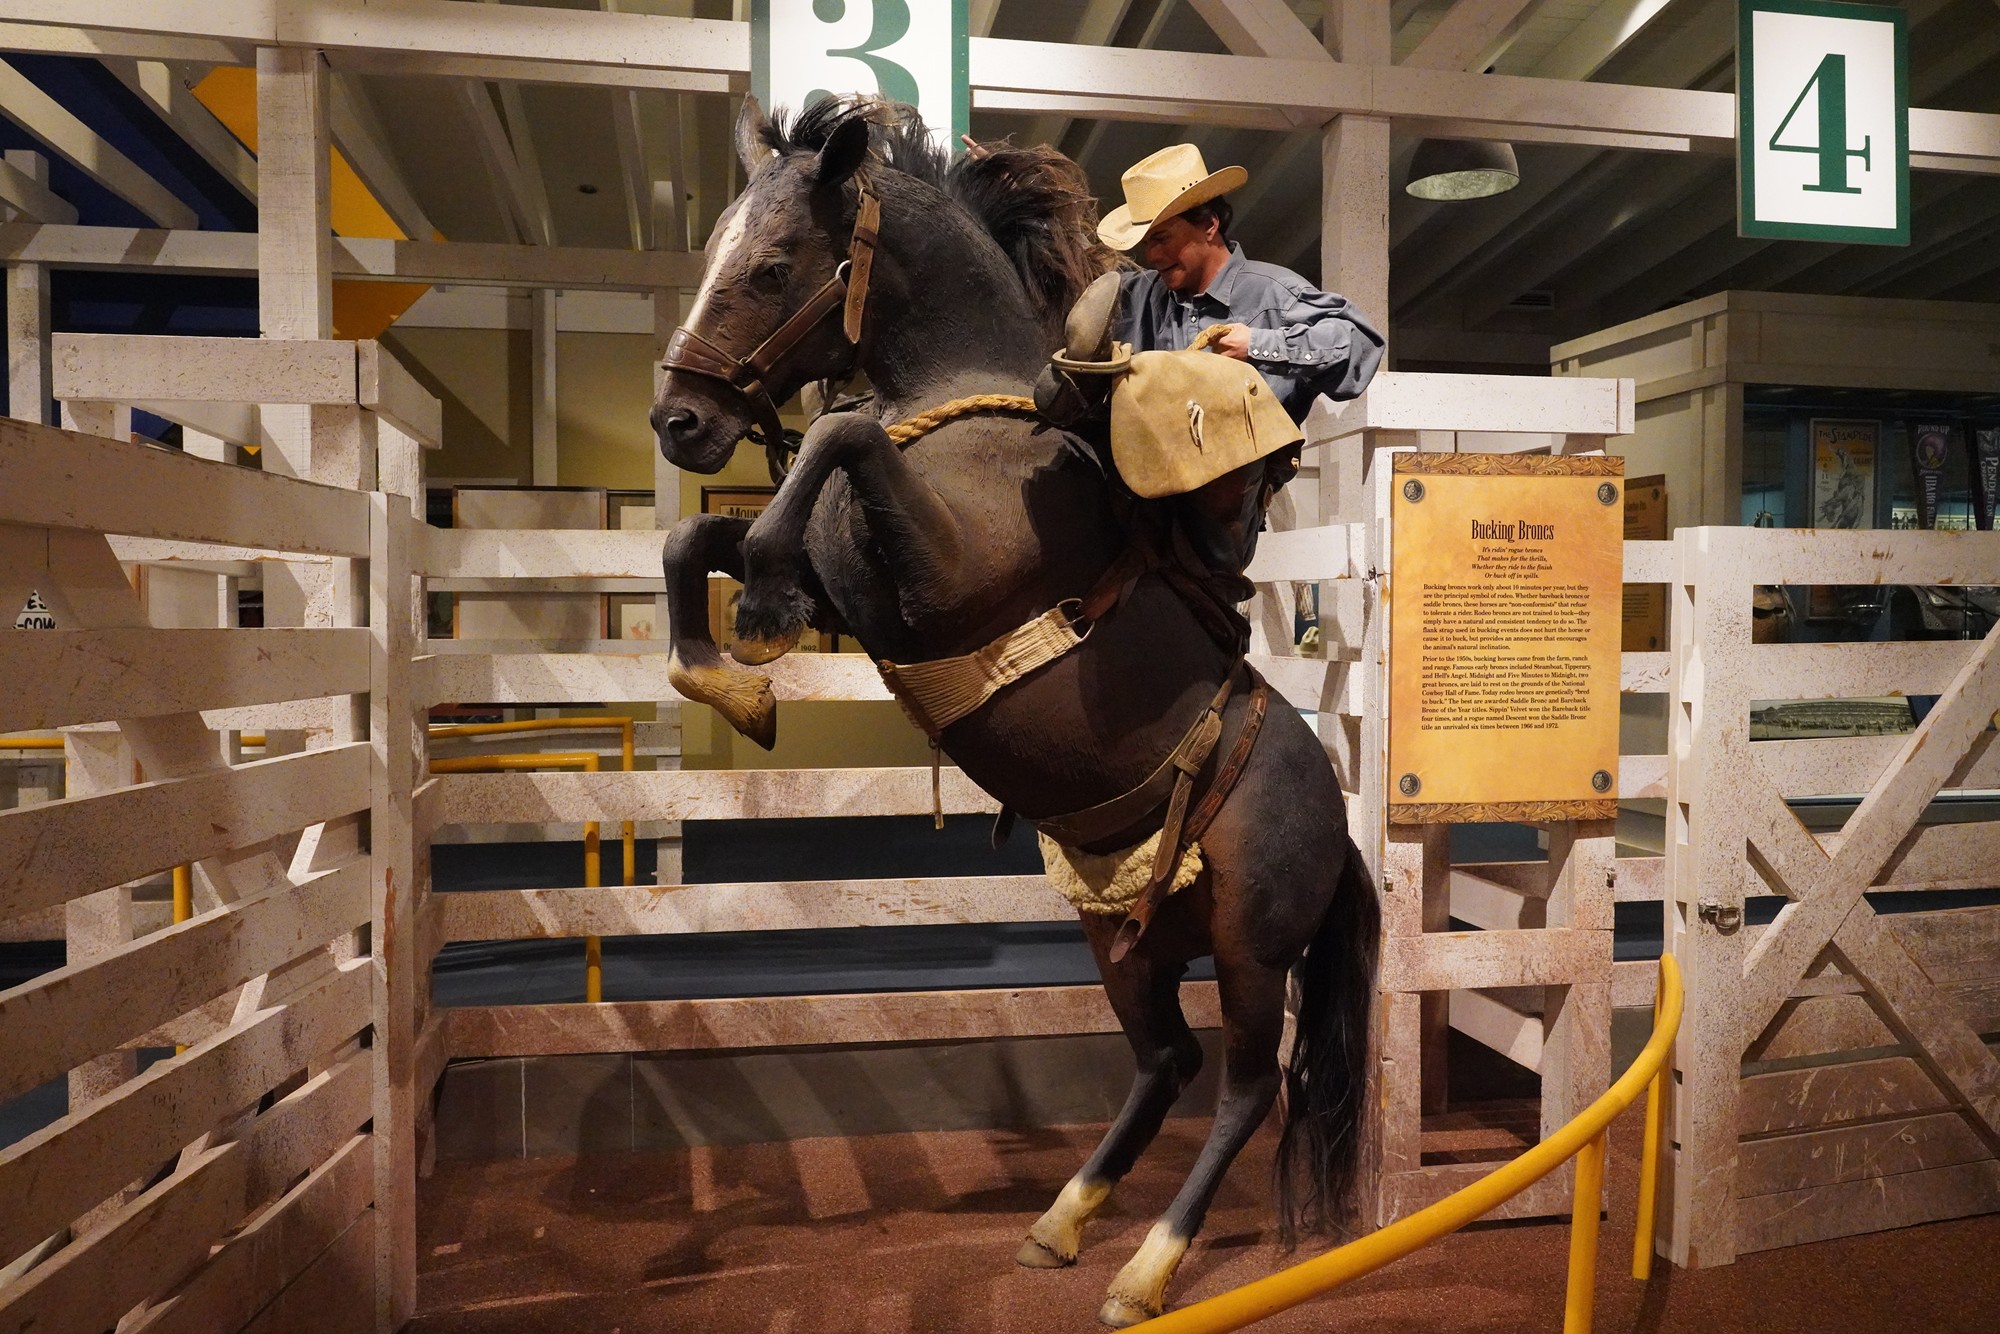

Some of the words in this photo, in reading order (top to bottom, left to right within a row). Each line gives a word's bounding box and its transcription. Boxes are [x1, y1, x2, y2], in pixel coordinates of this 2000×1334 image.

[803, 0, 920, 118] 3
[1769, 53, 1871, 194] 4
[1925, 475, 1937, 504] IDAHO
[1985, 456, 1999, 517] PENDLETON
[1472, 519, 1515, 543] Bucking
[1518, 519, 1555, 540] Broncs
[1495, 564, 1507, 572] they
[1424, 584, 1447, 592] Bucking
[1482, 584, 1494, 592] only
[1577, 584, 1589, 592] they
[1444, 592, 1469, 600] principal
[1470, 593, 1489, 601] symbol
[1439, 627, 1454, 635] strap
[1477, 627, 1499, 635] bucking
[1480, 636, 1504, 644] provides
[1474, 655, 1496, 663] bucking
[1474, 664, 1488, 672] early
[1469, 672, 1494, 680] Midnight
[1422, 690, 1444, 698] Cowboy
[1481, 689, 1498, 697] Today
[1545, 689, 1574, 697] genetically
